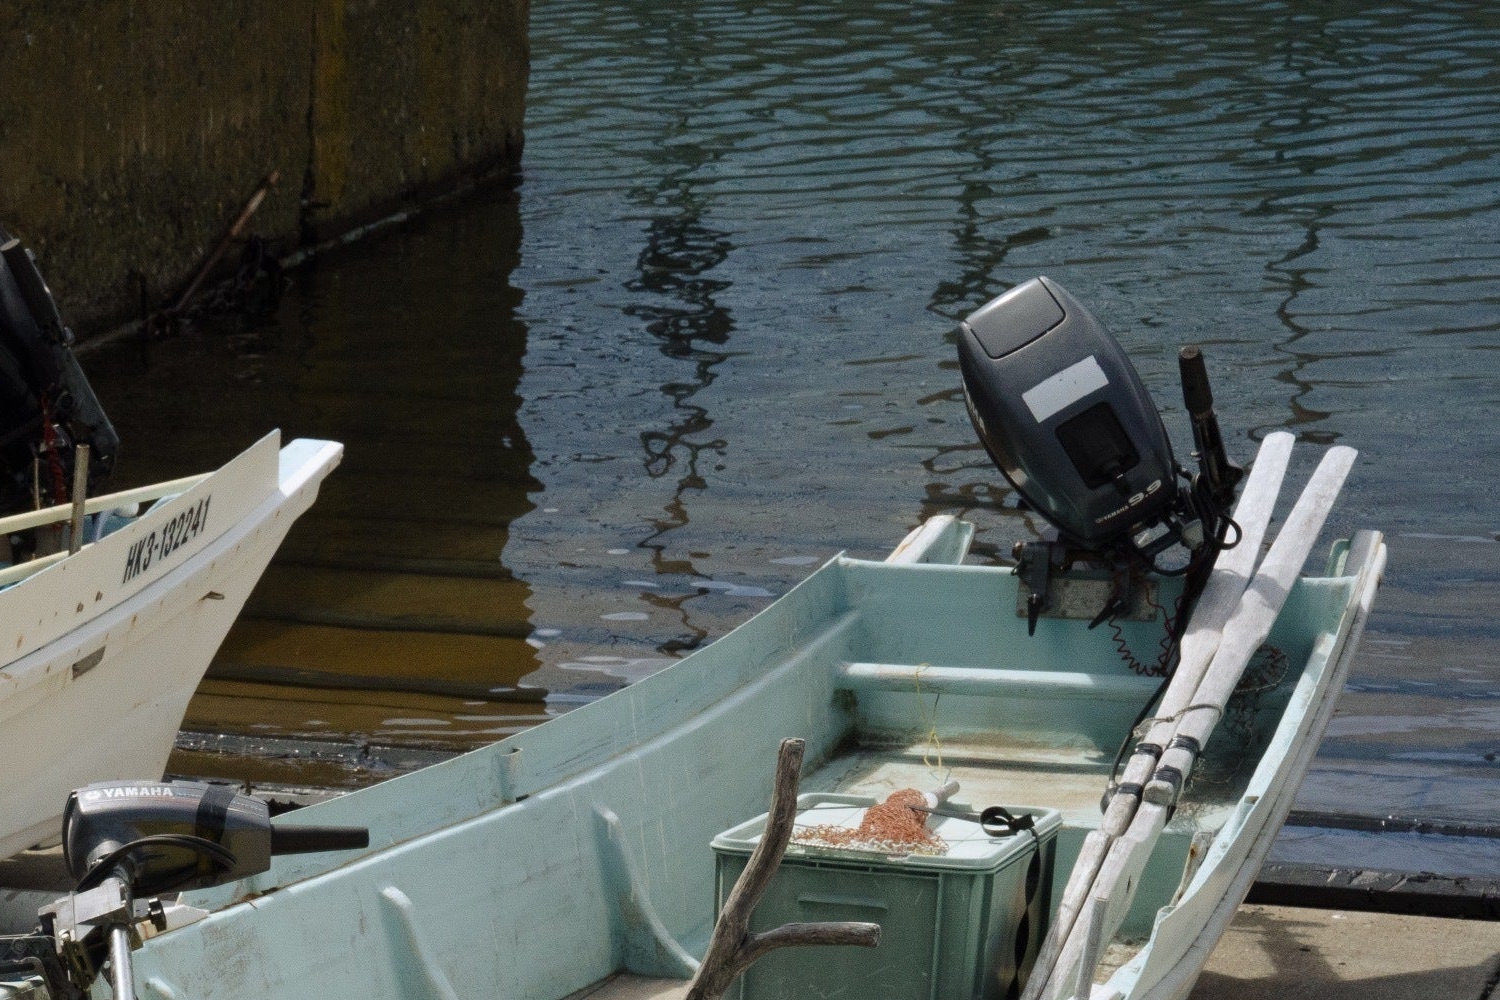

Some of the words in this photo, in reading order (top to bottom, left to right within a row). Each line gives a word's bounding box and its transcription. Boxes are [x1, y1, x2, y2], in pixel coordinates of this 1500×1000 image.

[1128, 479, 1162, 507] 9.9
[122, 493, 212, 584] HK3-132241
[102, 786, 174, 798] YAMAHA
